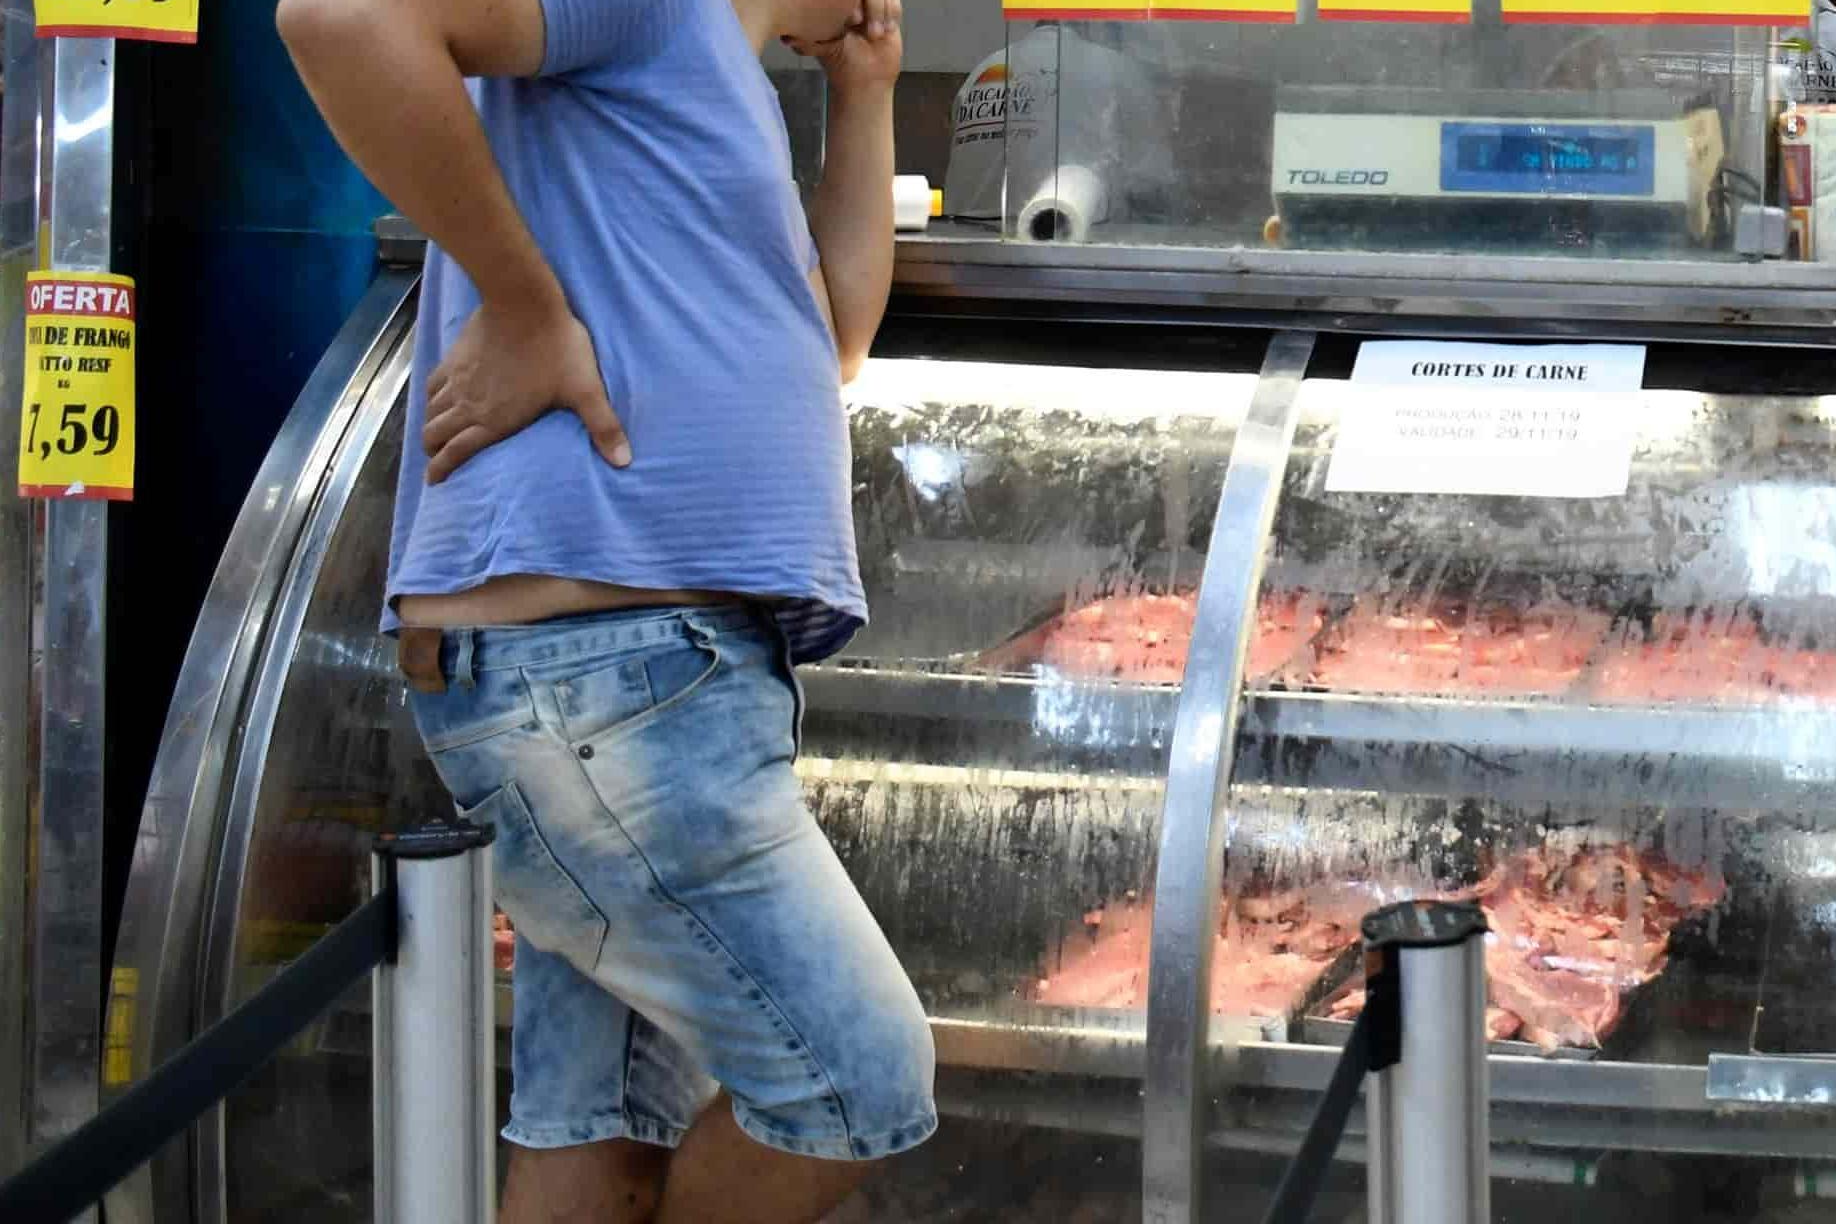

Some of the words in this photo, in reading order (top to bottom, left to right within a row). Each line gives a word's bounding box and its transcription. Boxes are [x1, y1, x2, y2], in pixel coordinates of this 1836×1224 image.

[1286, 168, 1390, 187] TOLEDO
[30, 284, 131, 315] OFERTA
[44, 325, 68, 347] DE
[78, 356, 112, 374] RESF
[1411, 361, 1485, 379] CORTES
[1492, 363, 1519, 380] DE
[1526, 364, 1589, 382] CARNE
